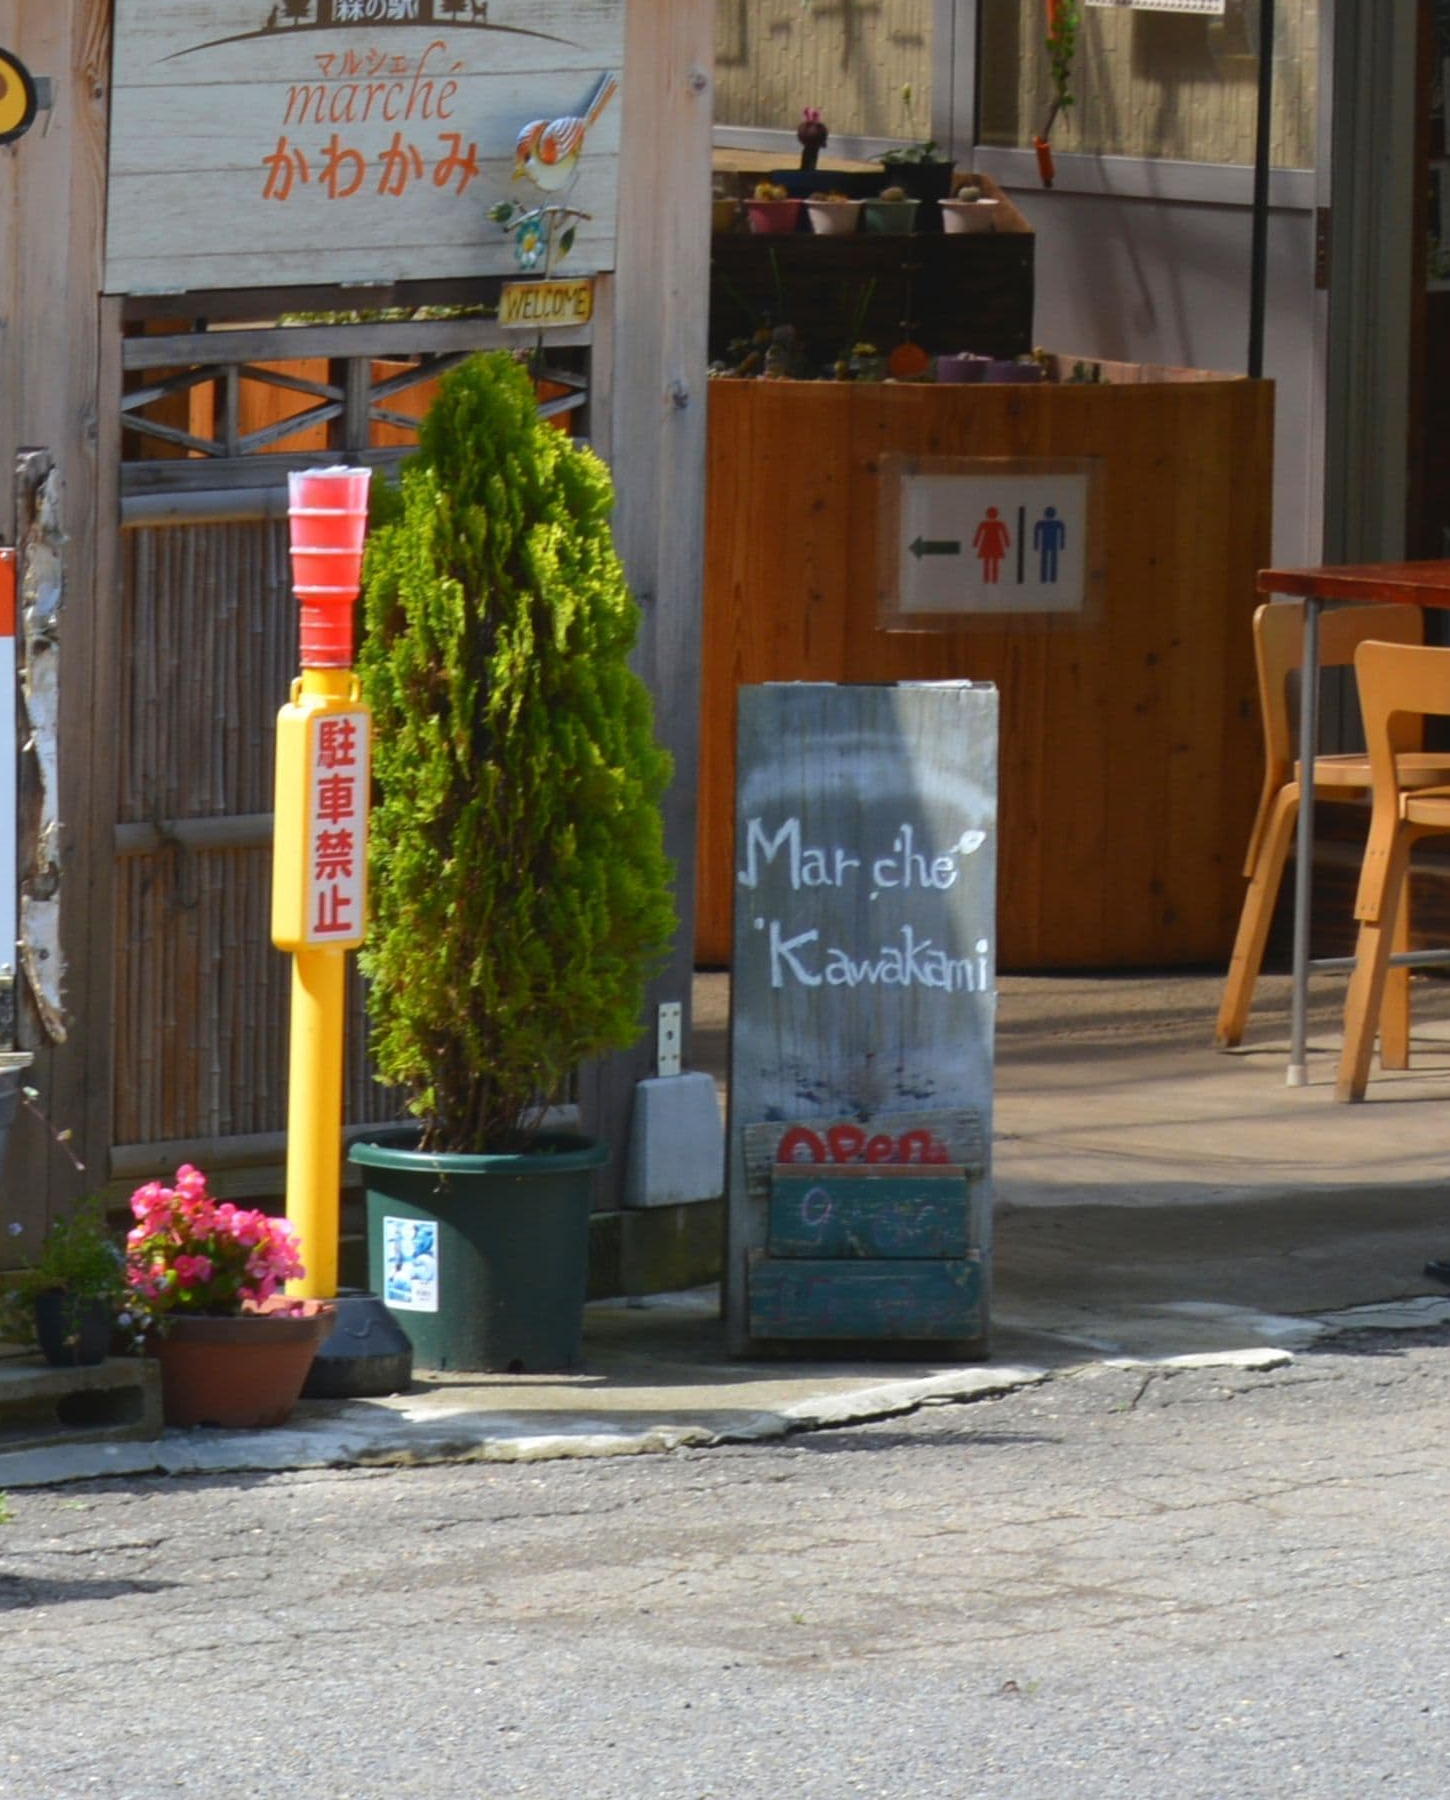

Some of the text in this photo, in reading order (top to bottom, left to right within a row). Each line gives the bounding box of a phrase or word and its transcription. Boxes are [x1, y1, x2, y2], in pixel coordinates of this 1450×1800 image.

[313, 45, 408, 77] マルシェ
[261, 131, 480, 201] かわかみ
[506, 288, 588, 320] WELCOME
[313, 719, 357, 934] 駐車禁止
